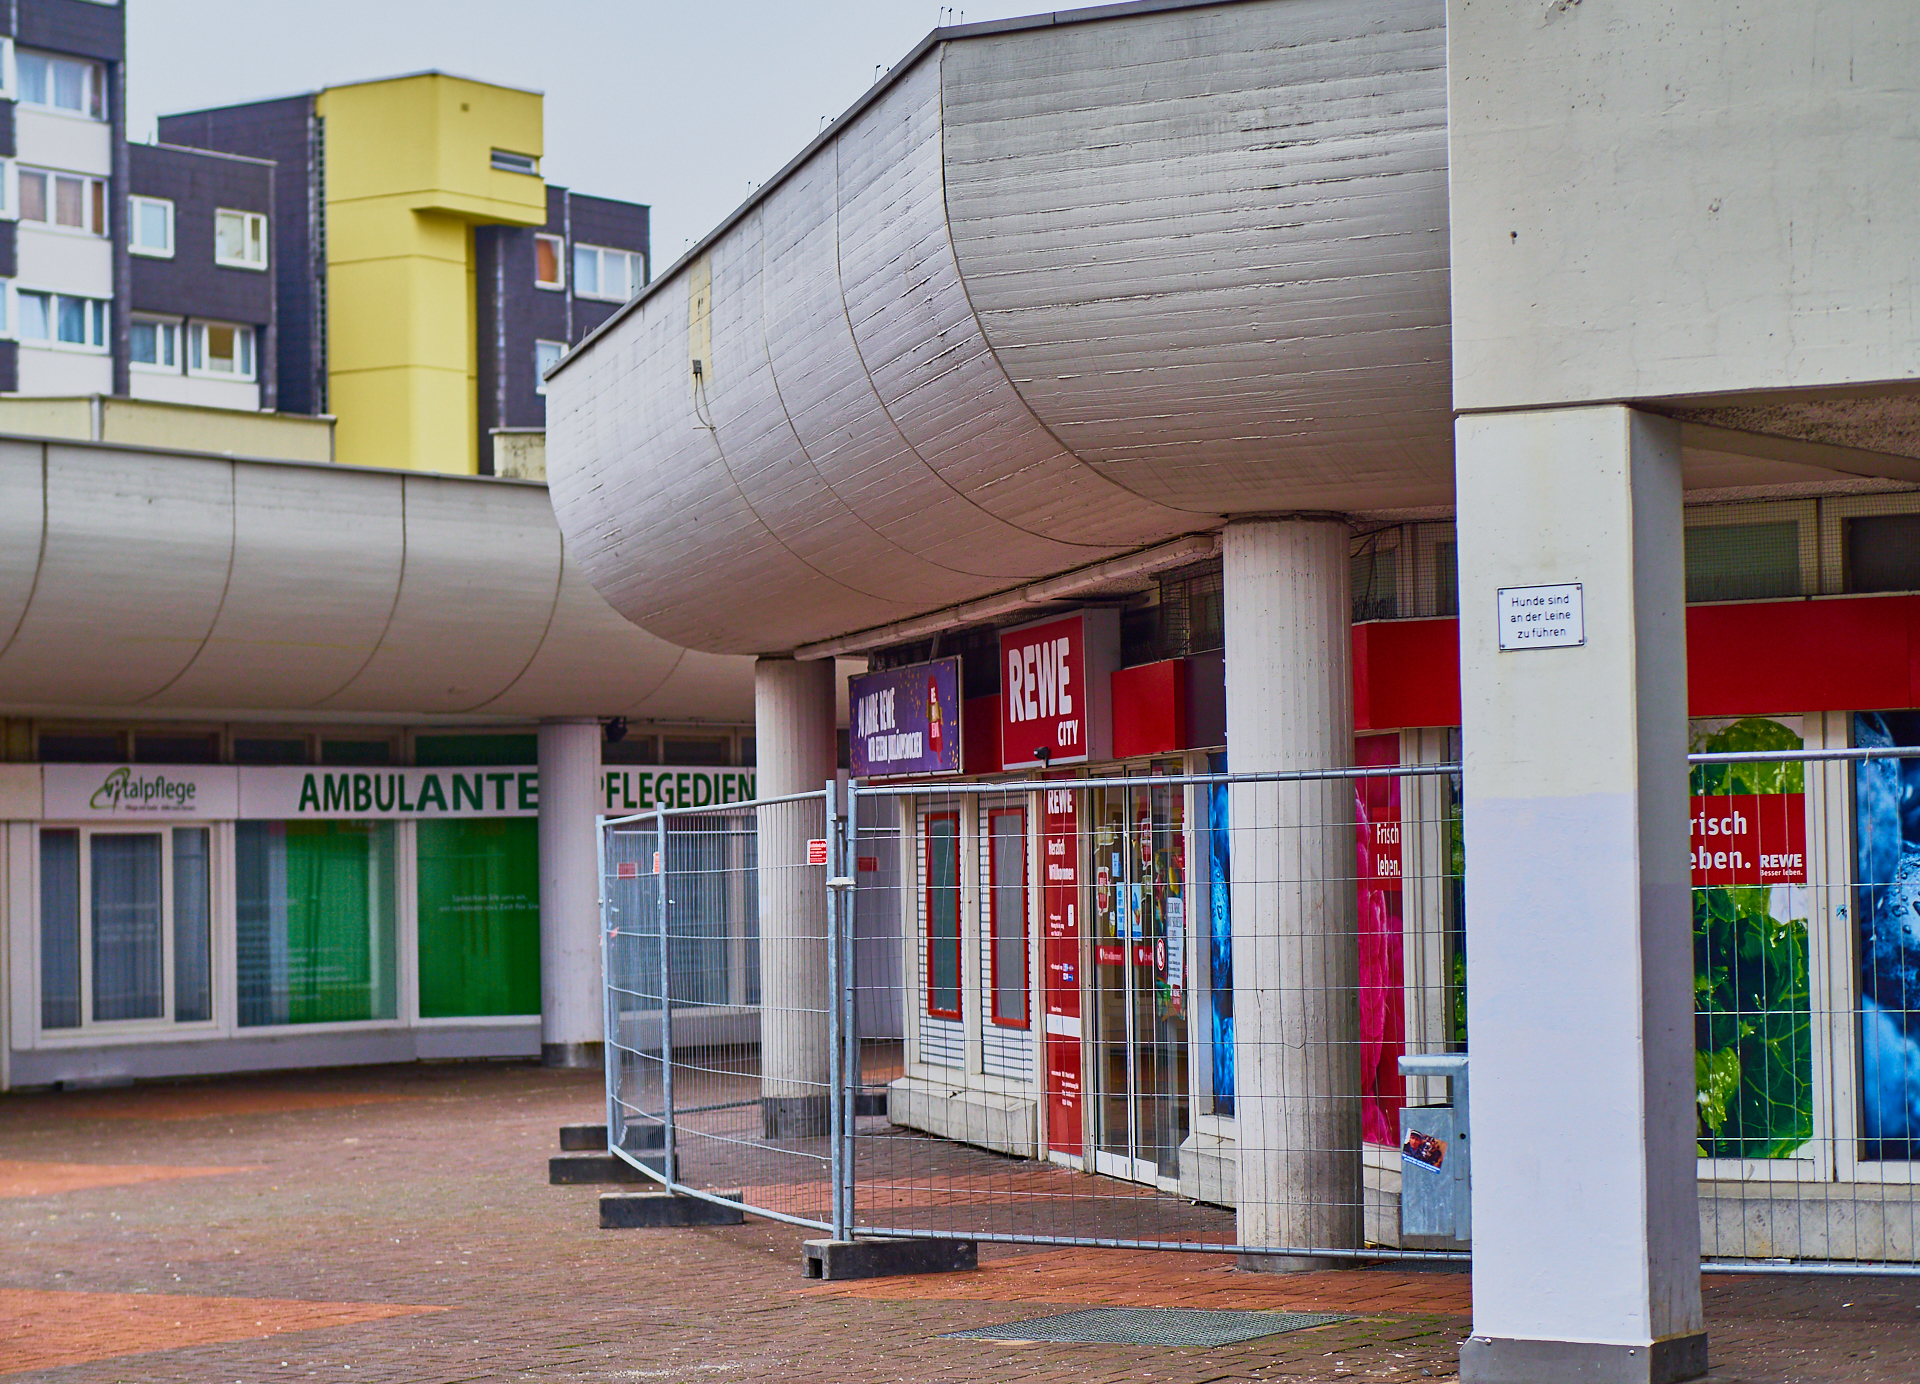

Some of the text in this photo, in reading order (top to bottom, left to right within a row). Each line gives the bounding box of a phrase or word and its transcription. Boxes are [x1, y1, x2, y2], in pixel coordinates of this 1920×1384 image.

[1511, 594, 1570, 607] Hunde sind
[1510, 610, 1571, 623] an der Leine
[1517, 627, 1567, 639] zu führen
[1008, 636, 1072, 723] REWE
[880, 687, 895, 731] REWE
[1057, 719, 1079, 746] CITY
[298, 772, 756, 812] AMBULANTE FLEGEDIEN
[1047, 789, 1073, 814] REWE
[1376, 822, 1399, 844] Frisch
[1376, 854, 1400, 876] leben.
[1761, 854, 1803, 867] REWE
